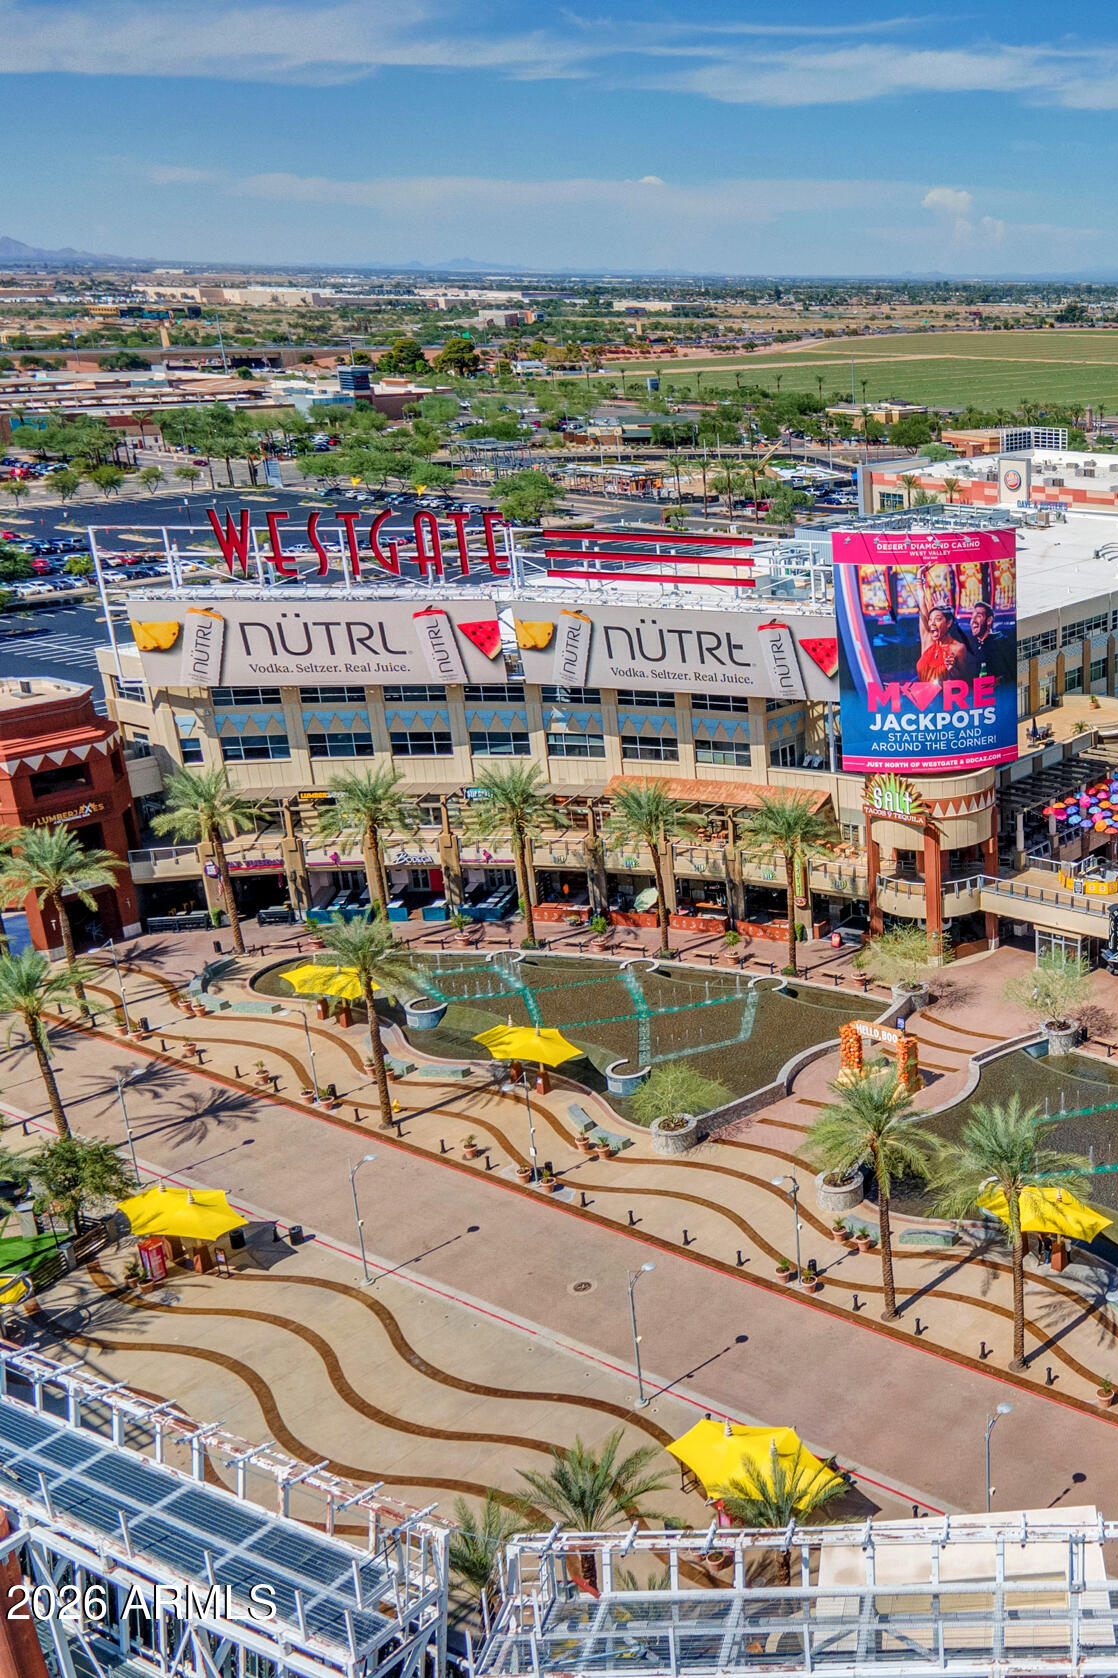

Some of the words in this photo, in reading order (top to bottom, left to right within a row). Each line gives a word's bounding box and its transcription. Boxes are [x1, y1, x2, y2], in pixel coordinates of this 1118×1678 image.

[206, 507, 512, 578] WESTGATE
[876, 542, 908, 551] DESERT
[951, 541, 981, 549] CASINO
[249, 662, 294, 675] Vodka.
[296, 662, 343, 674] Seltzer.
[344, 662, 373, 674] Real
[374, 662, 411, 674] Juice.
[610, 666, 649, 679] Vodka.
[650, 668, 692, 682] Seltzer.
[693, 670, 718, 683] Real
[719, 672, 754, 685] Juice.
[869, 707, 997, 732] JACKPOTS
[871, 742, 922, 751] AROUND
[925, 741, 947, 751] THE
[951, 735, 997, 749] CORNER!
[888, 730, 956, 742] STATEWIDE
[958, 728, 982, 738] AND
[921, 759, 958, 768] WESTGATE
[863, 807, 887, 818] TACOS
[893, 811, 925, 825] TEQUILA
